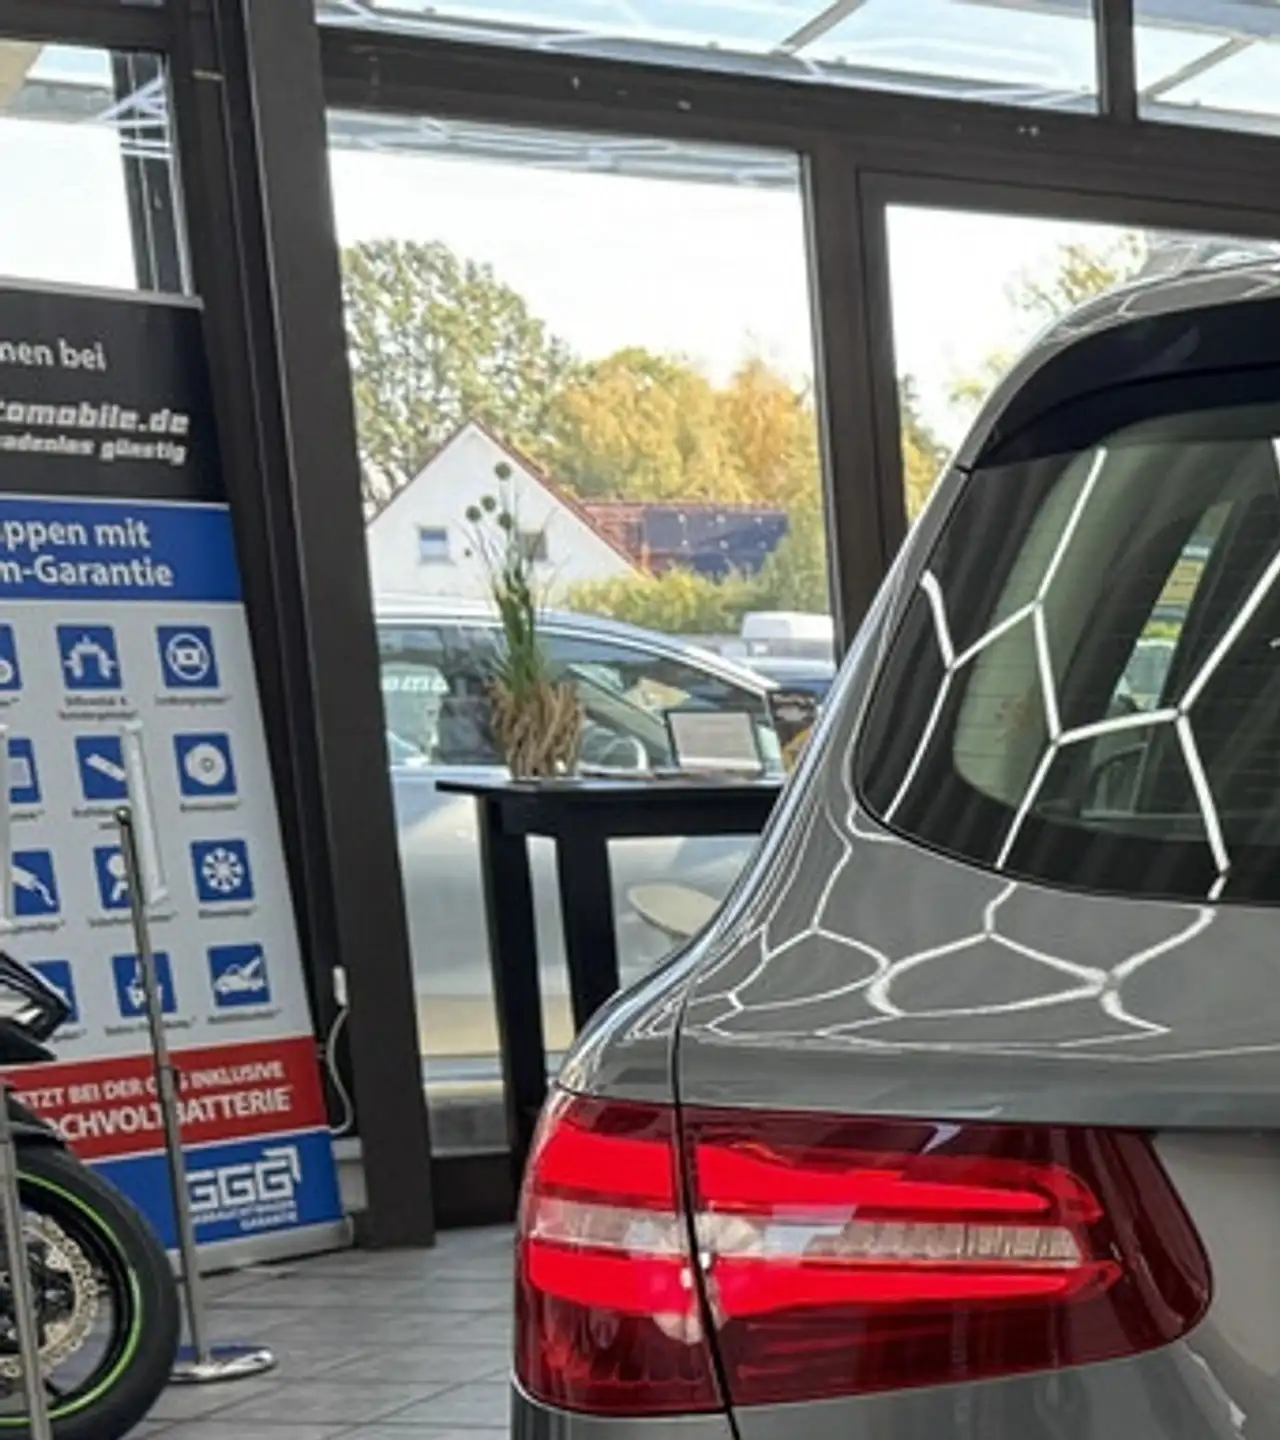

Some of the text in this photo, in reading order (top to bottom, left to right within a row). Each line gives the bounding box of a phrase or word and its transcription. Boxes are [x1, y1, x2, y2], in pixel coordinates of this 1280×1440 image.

[58, 336, 107, 371] bei
[0, 517, 152, 552] ppen mit
[104, 1076, 144, 1098] DER
[190, 1061, 285, 1089] INKLUSIVE
